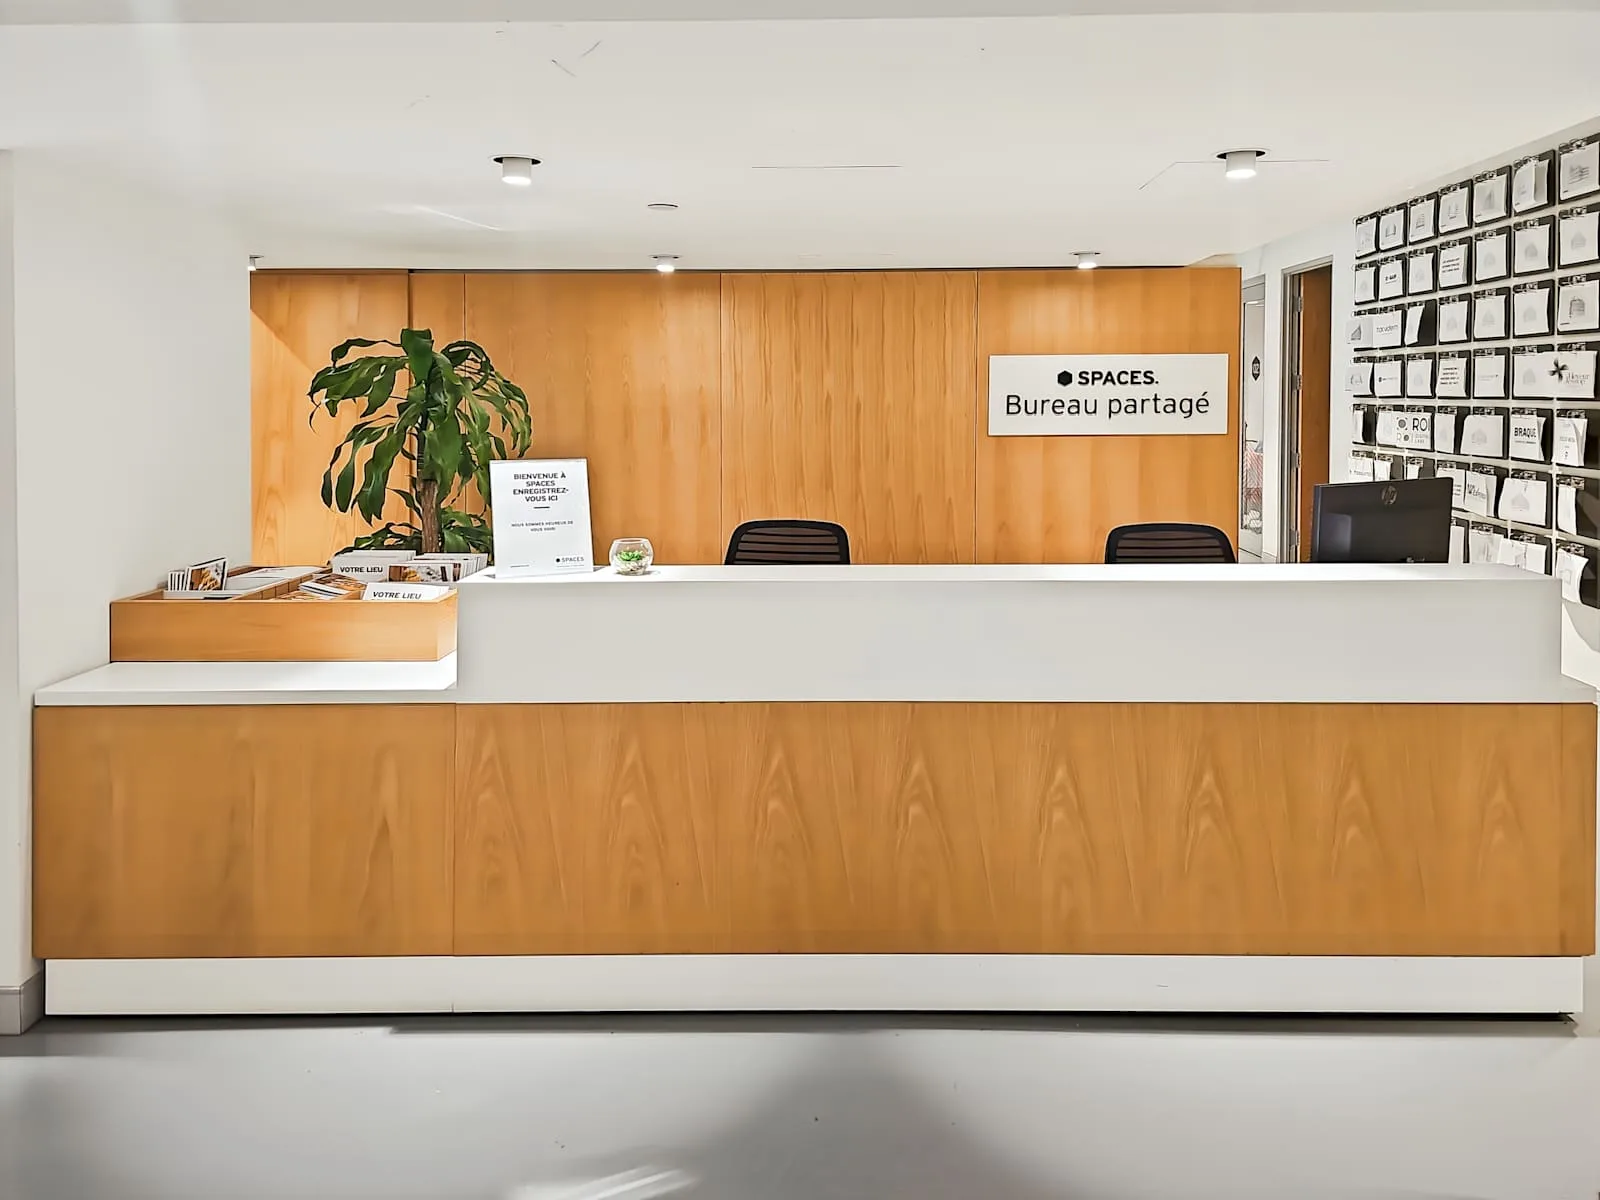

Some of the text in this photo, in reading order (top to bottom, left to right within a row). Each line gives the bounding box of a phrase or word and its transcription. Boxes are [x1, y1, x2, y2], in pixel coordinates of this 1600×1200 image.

[1077, 370, 1159, 386] SPACES.
[1006, 391, 1210, 419] Bureau partagé
[1514, 426, 1537, 439] BRAQUE
[560, 471, 567, 479] À
[513, 487, 569, 495] ENREGISTREZ-
[373, 591, 422, 600] VOTRE LIEU
